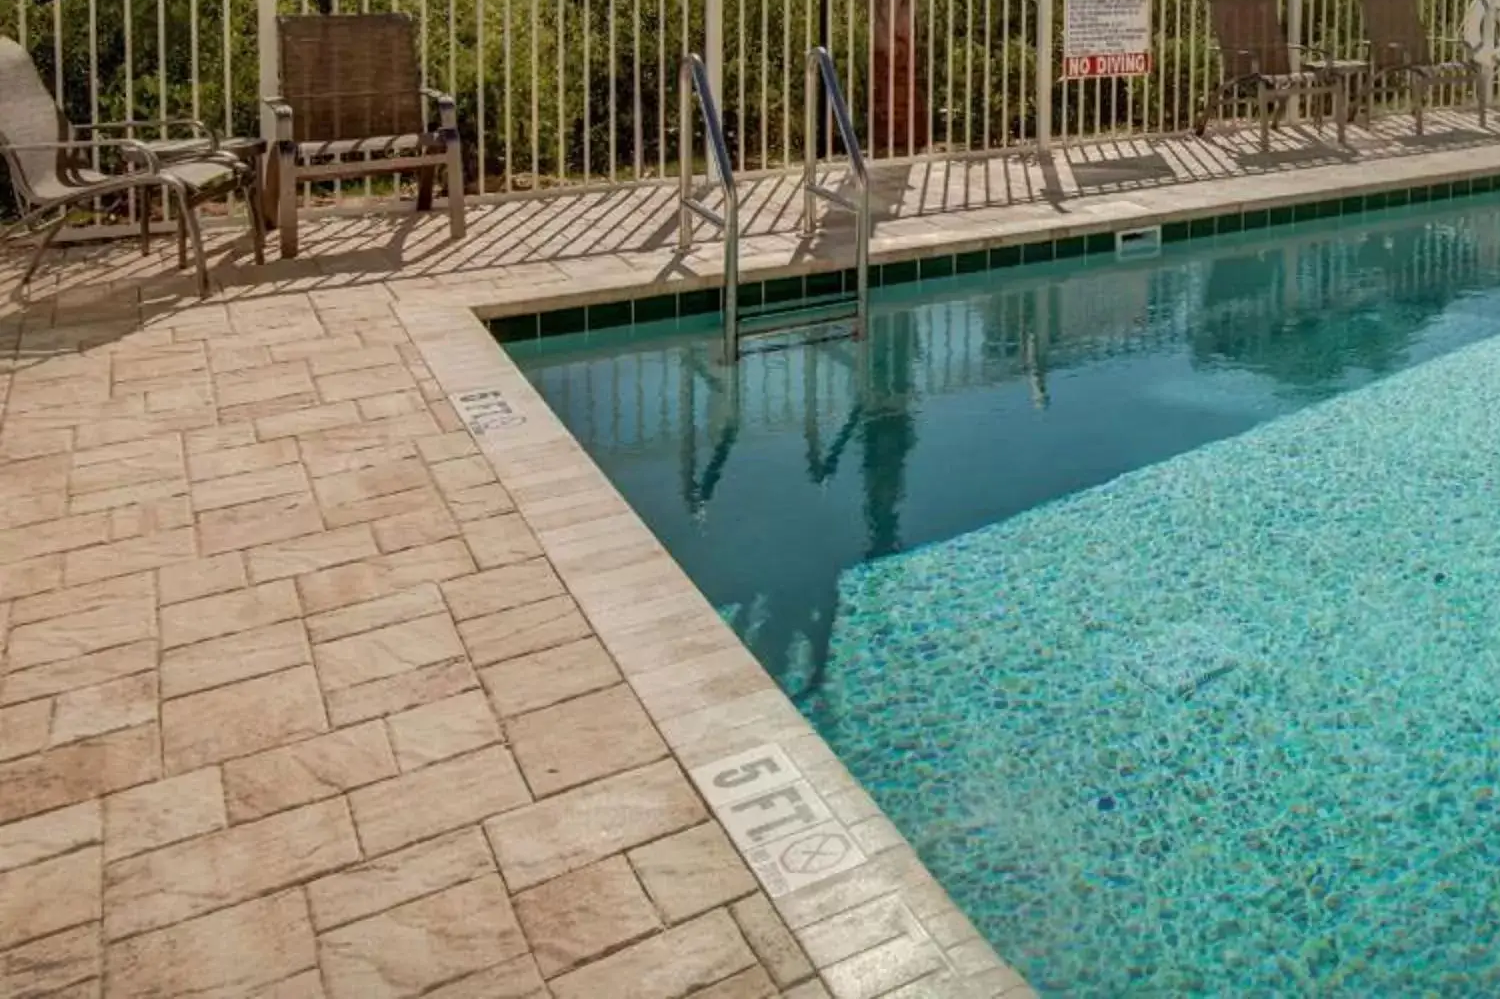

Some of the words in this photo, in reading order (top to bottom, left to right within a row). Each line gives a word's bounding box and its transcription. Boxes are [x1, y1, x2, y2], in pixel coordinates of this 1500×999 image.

[1069, 56, 1091, 76] NO
[1096, 53, 1145, 74] DIVING
[713, 757, 781, 788] 5
